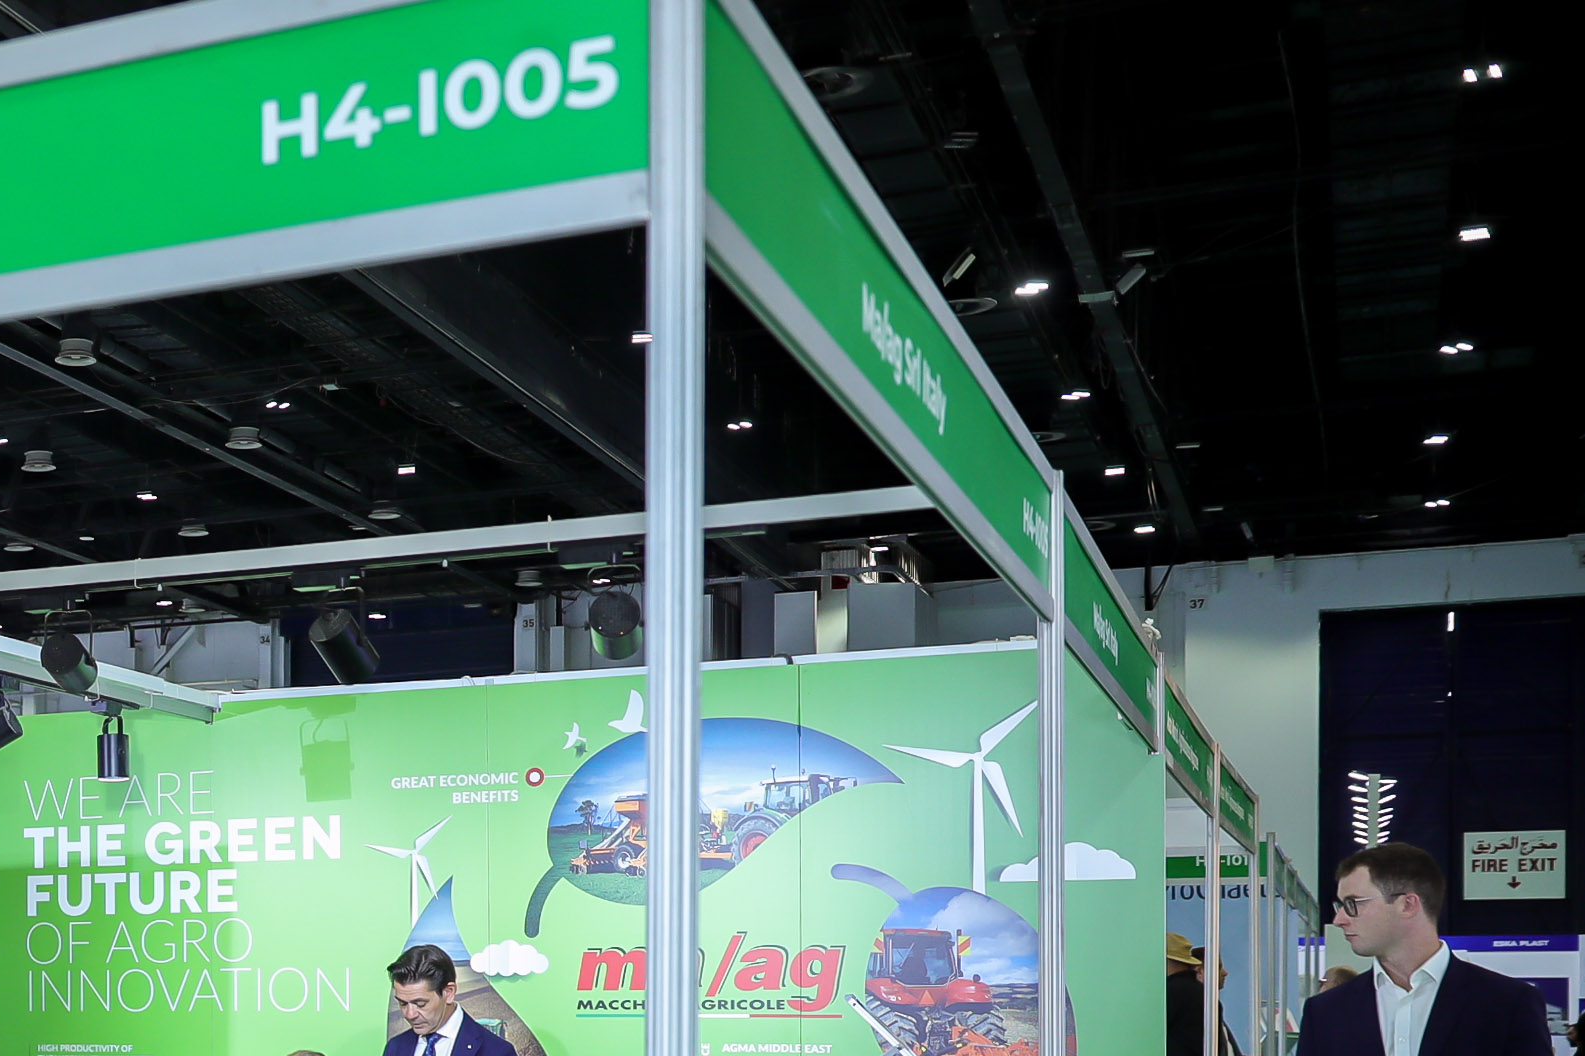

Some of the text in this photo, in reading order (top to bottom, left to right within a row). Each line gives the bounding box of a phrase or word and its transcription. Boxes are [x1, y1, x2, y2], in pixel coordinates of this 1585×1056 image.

[1189, 599, 1205, 609] 37
[391, 772, 519, 789] GREAT ECONOMIC
[24, 770, 215, 821] WE ARE
[452, 790, 519, 804] BENEFITS
[23, 815, 342, 869] THE GREEN
[1472, 858, 1557, 872] FIRE EXIT
[27, 869, 238, 917] FUTURE
[26, 917, 253, 965] OF AGRO
[576, 931, 846, 1012] m/ag
[29, 967, 351, 1012] INNOVATION
[577, 1000, 647, 1010] MACCH
[38, 1044, 133, 1053] HIGH PRODUCTIVITY OF
[722, 1044, 832, 1054] AGMA MIDDLE EAST
